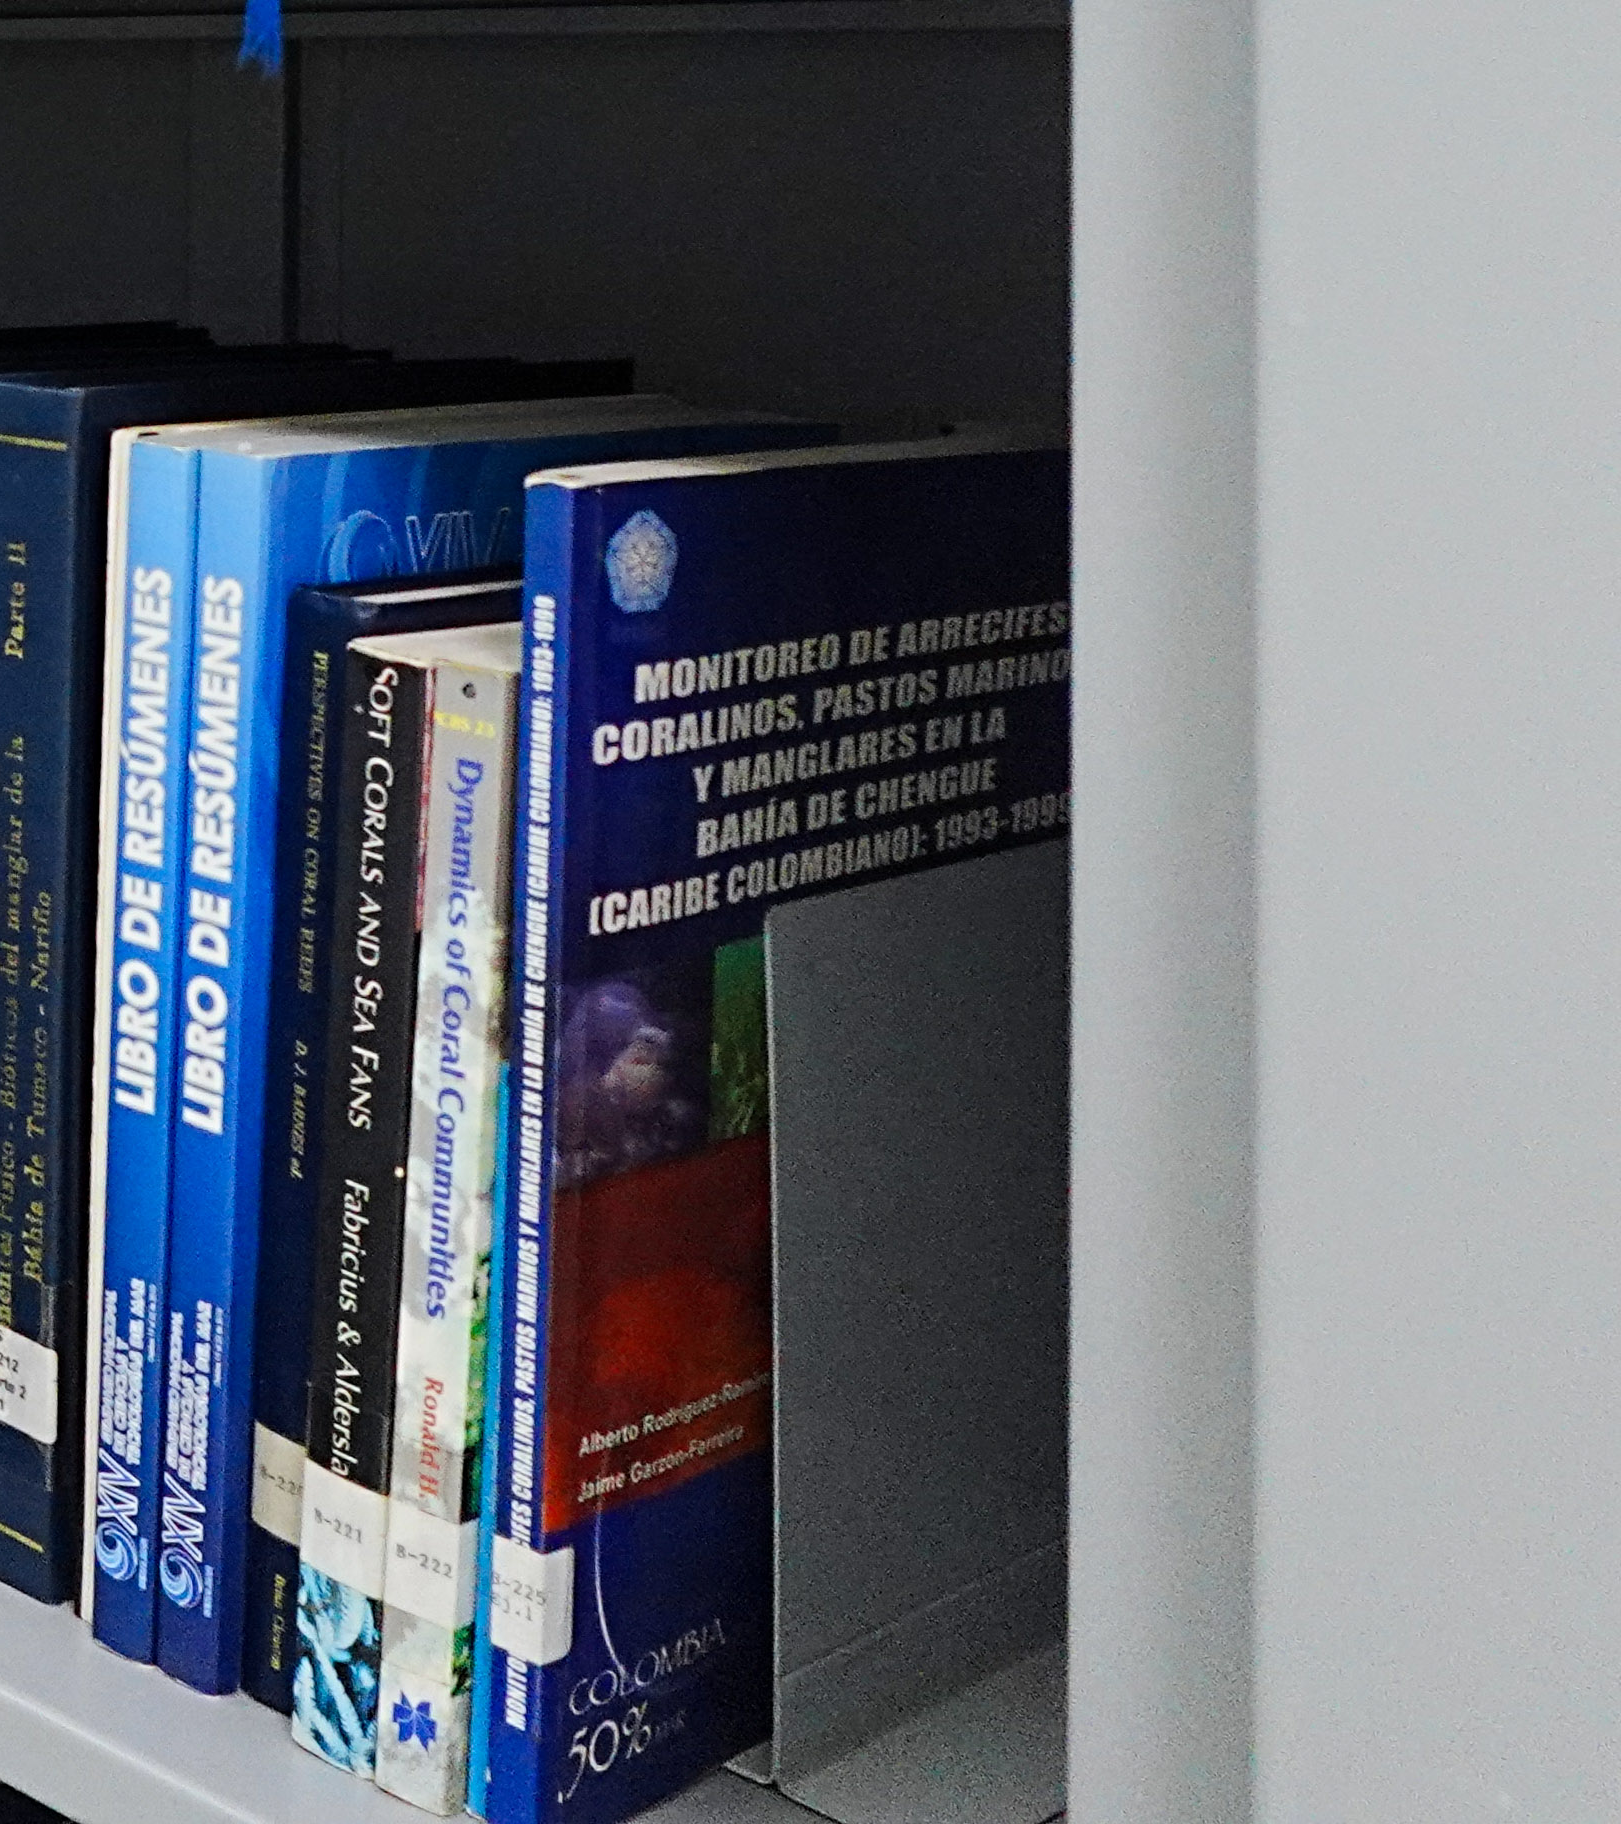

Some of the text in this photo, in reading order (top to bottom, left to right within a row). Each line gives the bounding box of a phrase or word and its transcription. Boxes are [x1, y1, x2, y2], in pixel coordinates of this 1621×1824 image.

[4, 542, 28, 658] Parte II
[634, 600, 1069, 704] MONITOREO DE ARRECIFES
[691, 707, 1007, 804] Y MANGLARES EN LA
[695, 757, 998, 859] BAHÍA DE CHENGUE
[113, 566, 174, 1115] LIBRO DE RESÚMENES
[180, 575, 244, 1136] LIBRO DE RESÚMENES
[297, 650, 329, 994] PERSPECTIVES ON CORAL REEFS
[345, 666, 401, 1130] SOFT CORALS AND SEA FANS
[424, 757, 487, 1320] Dynamics of Coral Communities
[336, 1178, 371, 1311] Fabricius
[336, 1322, 361, 1347] &
[394, 1543, 456, 1580] B-222
